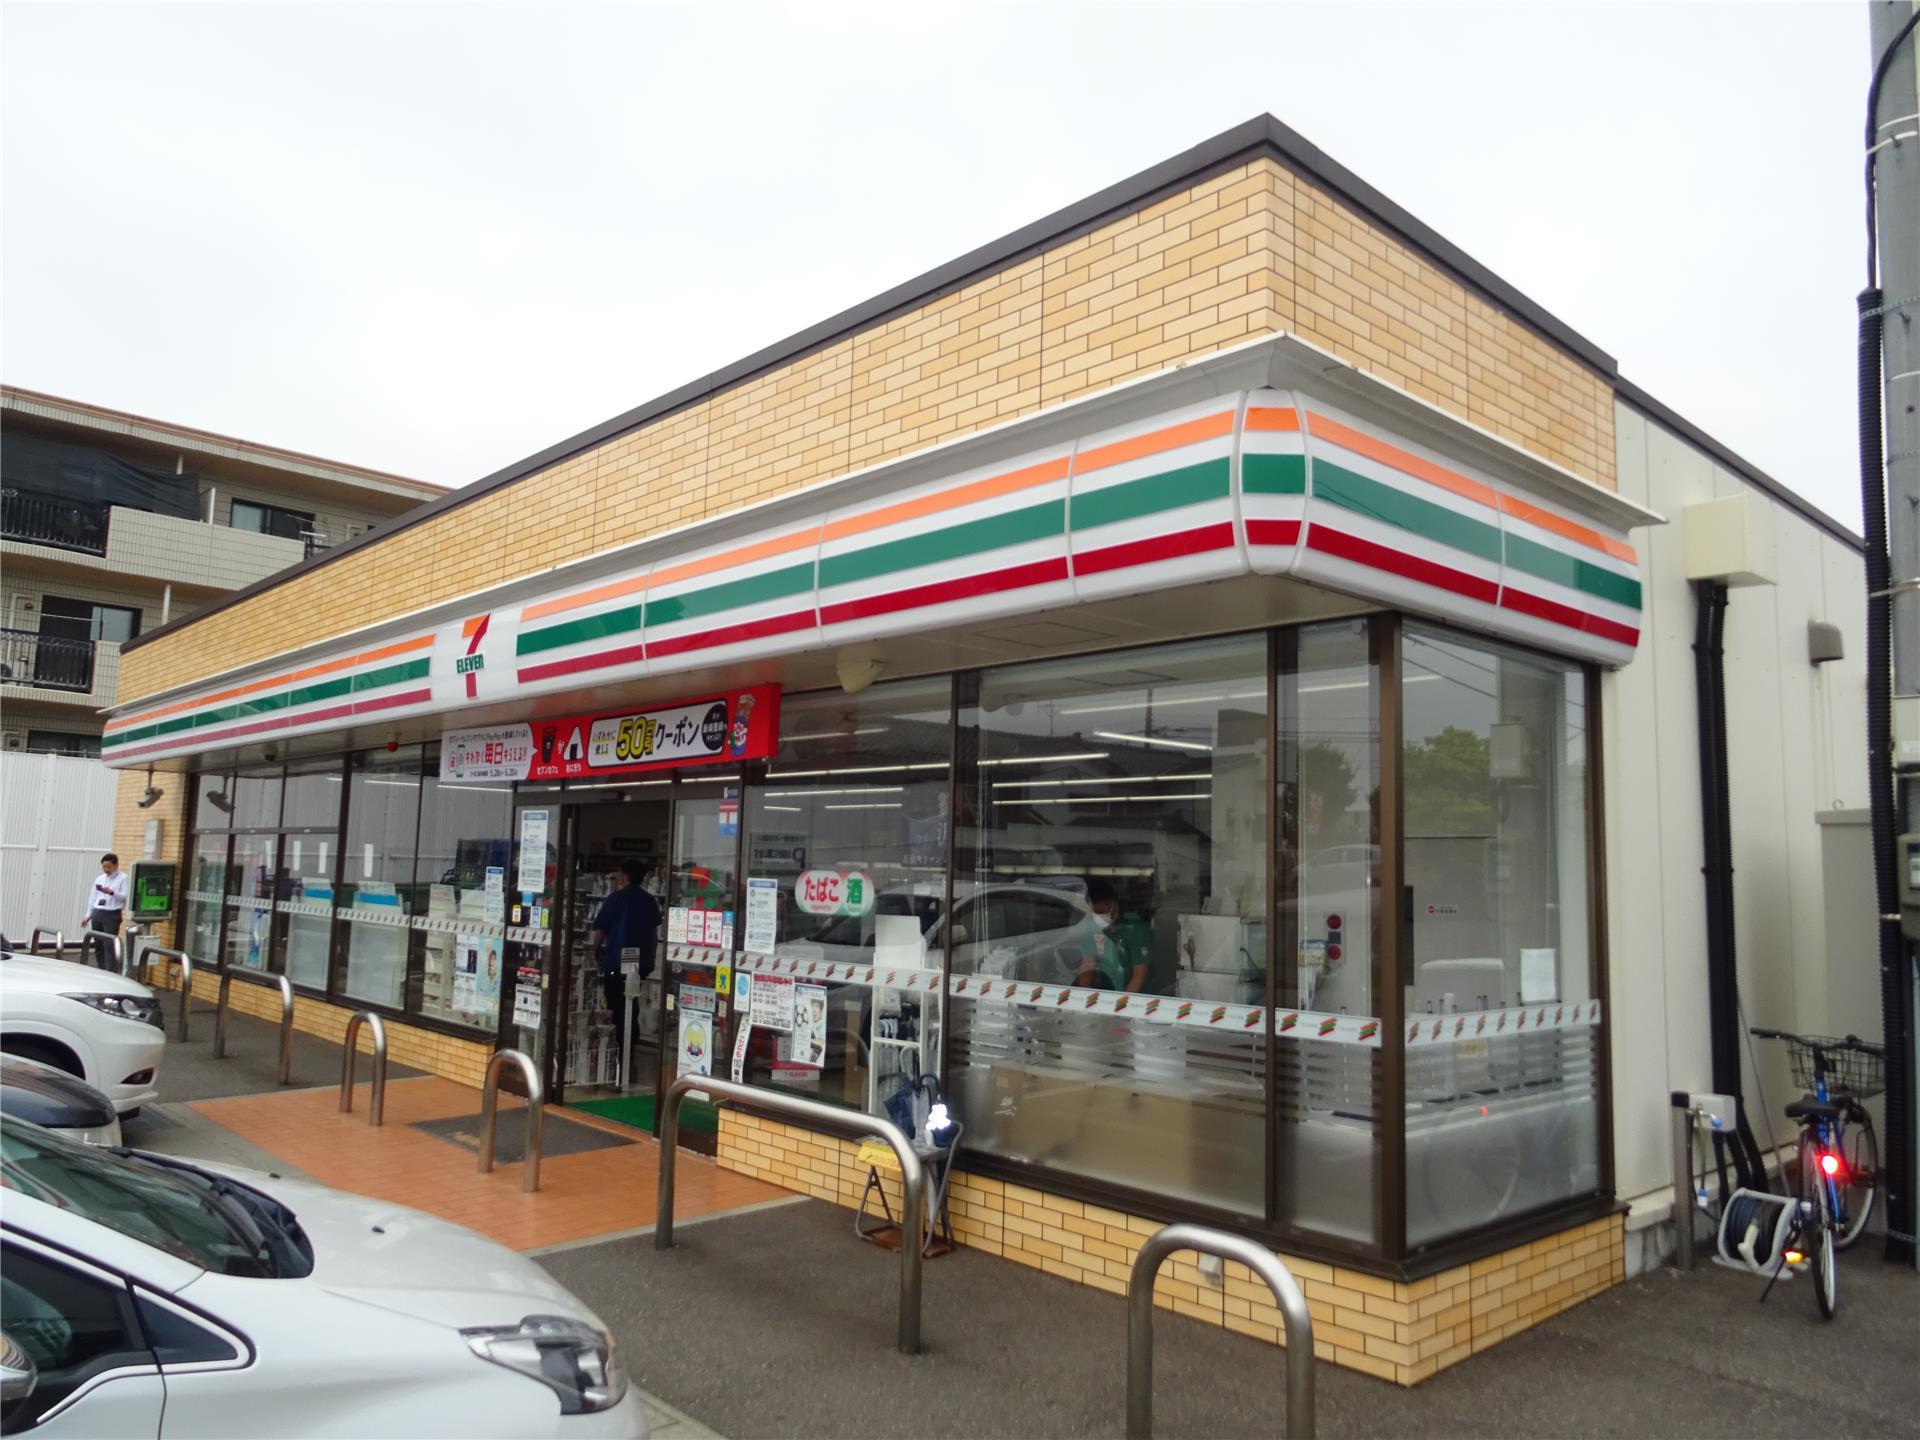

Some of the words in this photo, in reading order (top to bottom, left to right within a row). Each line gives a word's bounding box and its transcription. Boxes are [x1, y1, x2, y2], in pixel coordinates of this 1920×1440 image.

[804, 877, 839, 902] たばこ
[846, 878, 863, 904] 酒
